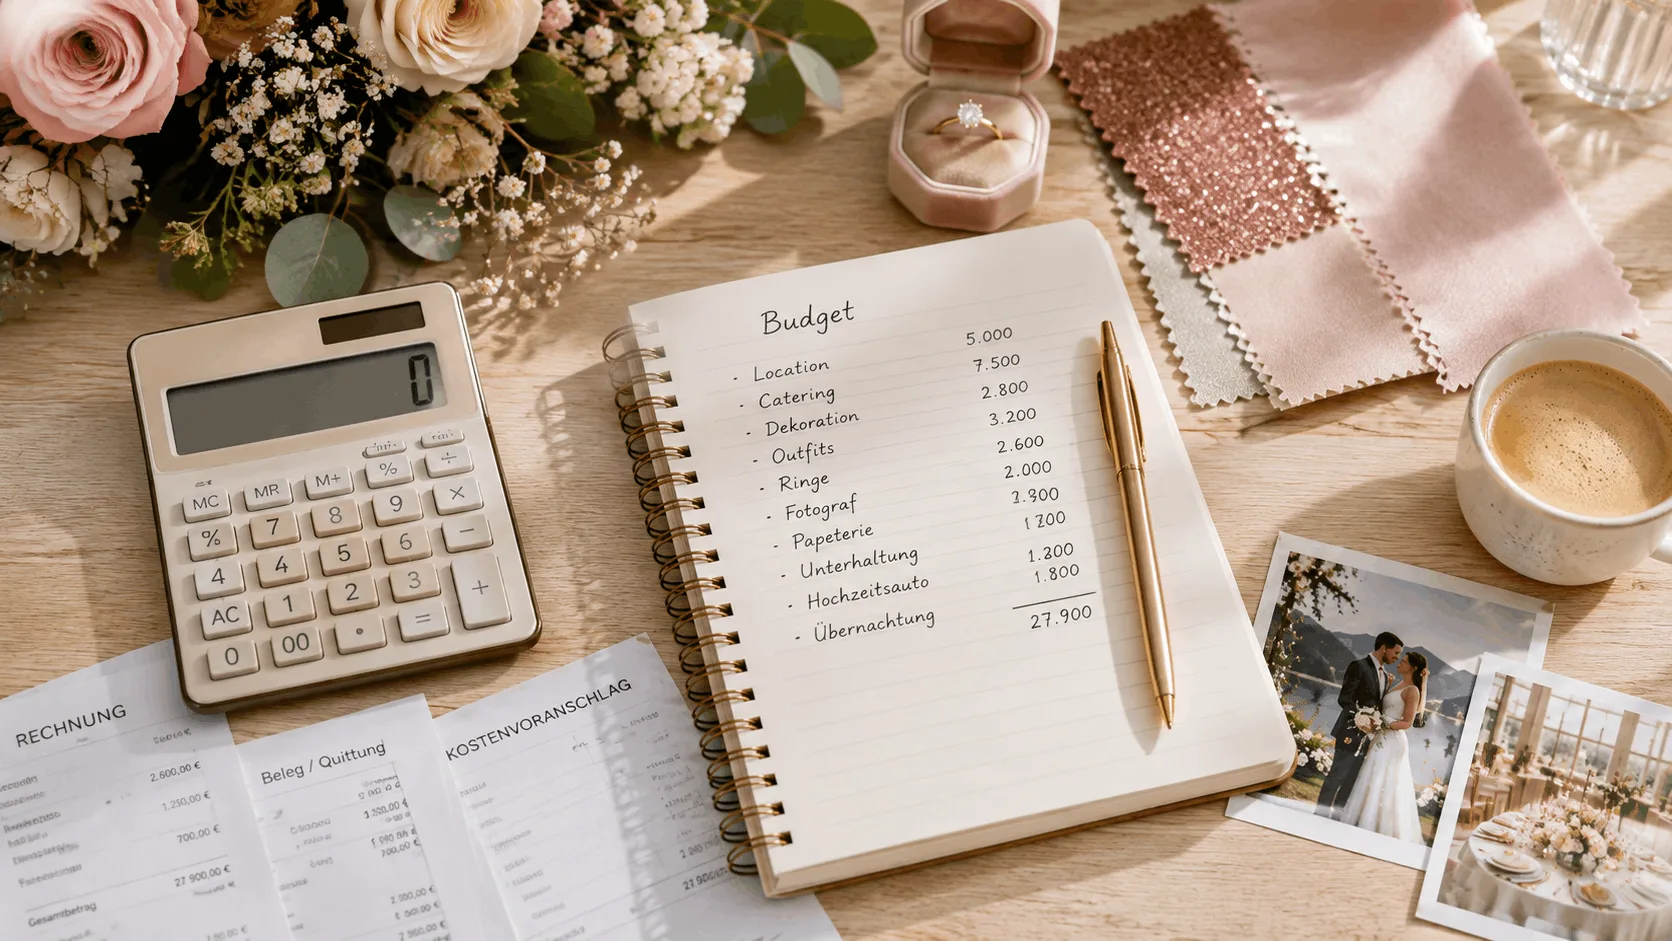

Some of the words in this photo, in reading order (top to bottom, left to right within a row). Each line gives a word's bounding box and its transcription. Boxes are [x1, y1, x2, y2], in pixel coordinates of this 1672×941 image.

[761, 301, 854, 334] Budget
[967, 327, 1012, 345] 5.000
[755, 361, 829, 381] Location
[973, 354, 1020, 372] 7.500
[408, 353, 434, 406] 0
[759, 389, 834, 408] Catering
[982, 381, 1028, 399] 2.800
[766, 412, 859, 436] Dekoration
[990, 408, 1036, 426] 3.200
[772, 442, 835, 464] Outfits
[998, 436, 1043, 453] 2.600
[1005, 461, 1051, 478] 2.000
[315, 473, 341, 488] M+
[779, 473, 829, 493] Ringe
[253, 483, 280, 499] MR
[192, 494, 220, 511] MC
[389, 495, 403, 513] 9
[786, 493, 857, 521] Fotograf
[328, 506, 343, 524] 8
[266, 517, 279, 536] 7
[399, 532, 413, 551] 6
[792, 523, 874, 552] Papeterie
[337, 543, 351, 562] 5
[275, 555, 289, 573] 4
[800, 547, 919, 579] Unterhaltung
[211, 567, 226, 585] 4
[407, 571, 422, 589] 3
[1035, 564, 1079, 582] 1.800
[344, 582, 360, 602] 2
[807, 575, 929, 610] Hochzeitsauto
[282, 594, 293, 613] 1
[211, 605, 240, 626] AC
[1030, 604, 1092, 630] 27.900
[814, 610, 935, 642] Übernachtung
[281, 632, 310, 654] 00
[224, 647, 240, 666] 0
[15, 704, 127, 748] RECHNUNG
[445, 678, 632, 761] KOSTENVORANSCHLAG
[260, 765, 305, 785] Beleg
[309, 758, 314, 773] /
[318, 743, 386, 768] Quittung
[176, 827, 211, 844] 700,00
[28, 902, 97, 928] Gesamtbetrag
